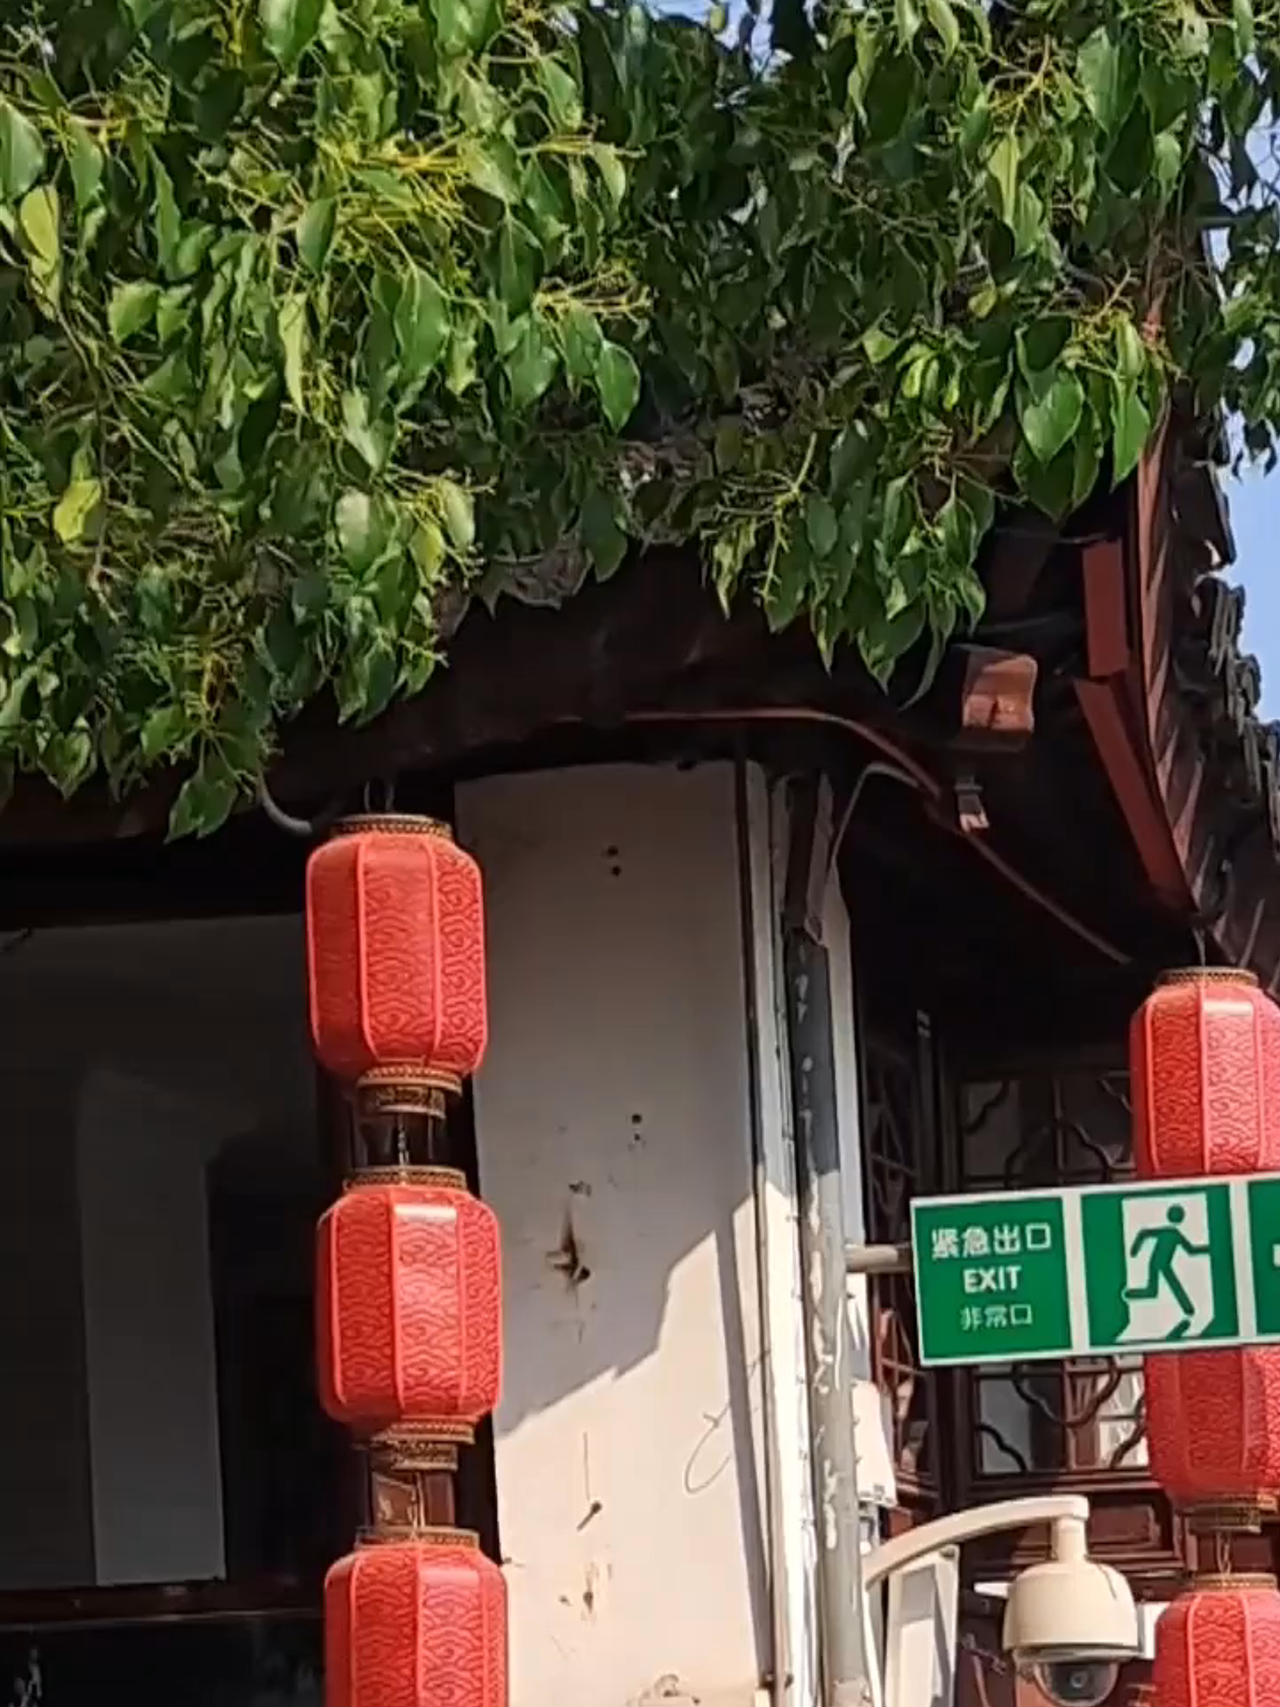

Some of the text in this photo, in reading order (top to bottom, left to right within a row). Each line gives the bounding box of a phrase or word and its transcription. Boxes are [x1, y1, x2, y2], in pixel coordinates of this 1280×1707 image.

[932, 1223, 1051, 1260] 紧急出口
[963, 1265, 1022, 1294] EXIT
[960, 1304, 1033, 1331] 非常口
